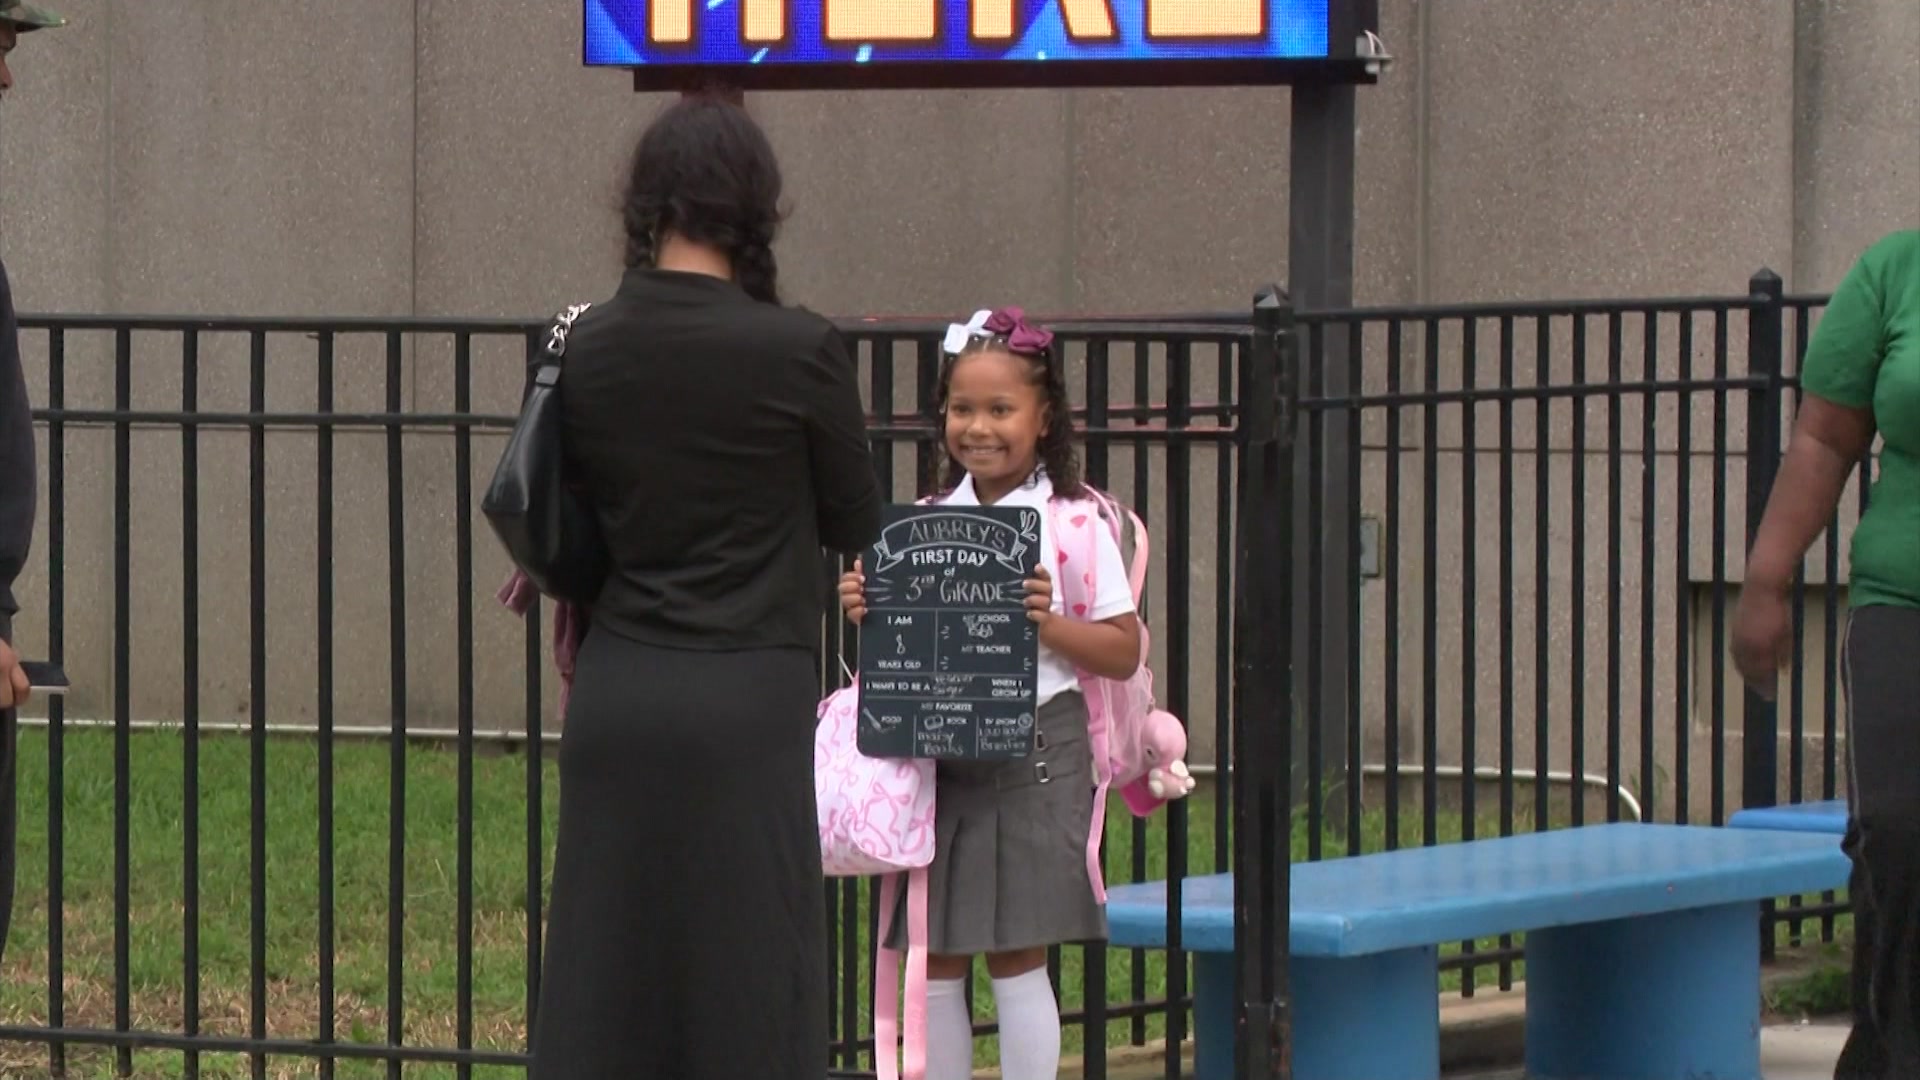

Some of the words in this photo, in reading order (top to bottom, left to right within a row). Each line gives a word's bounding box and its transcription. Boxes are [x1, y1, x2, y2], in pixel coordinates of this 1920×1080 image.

[909, 520, 1005, 550] AUBREY'S
[912, 550, 953, 565] FIRST
[957, 551, 988, 566] DAY
[944, 567, 955, 577] of
[940, 579, 1004, 604] GRADE
[887, 616, 892, 625] I
[894, 616, 912, 625] AM
[978, 613, 1010, 623] SCHOOL
[976, 645, 1011, 654] TEACHER
[878, 660, 902, 669] YEARS
[904, 660, 921, 669] OLD
[866, 682, 870, 690] I
[872, 682, 895, 690] WANT
[898, 682, 909, 690] TO
[911, 682, 921, 691] BE
[991, 688, 1018, 697] GROW
[1020, 689, 1031, 697] UP
[935, 702, 972, 712] FAVORITE
[947, 717, 967, 725] BOOK
